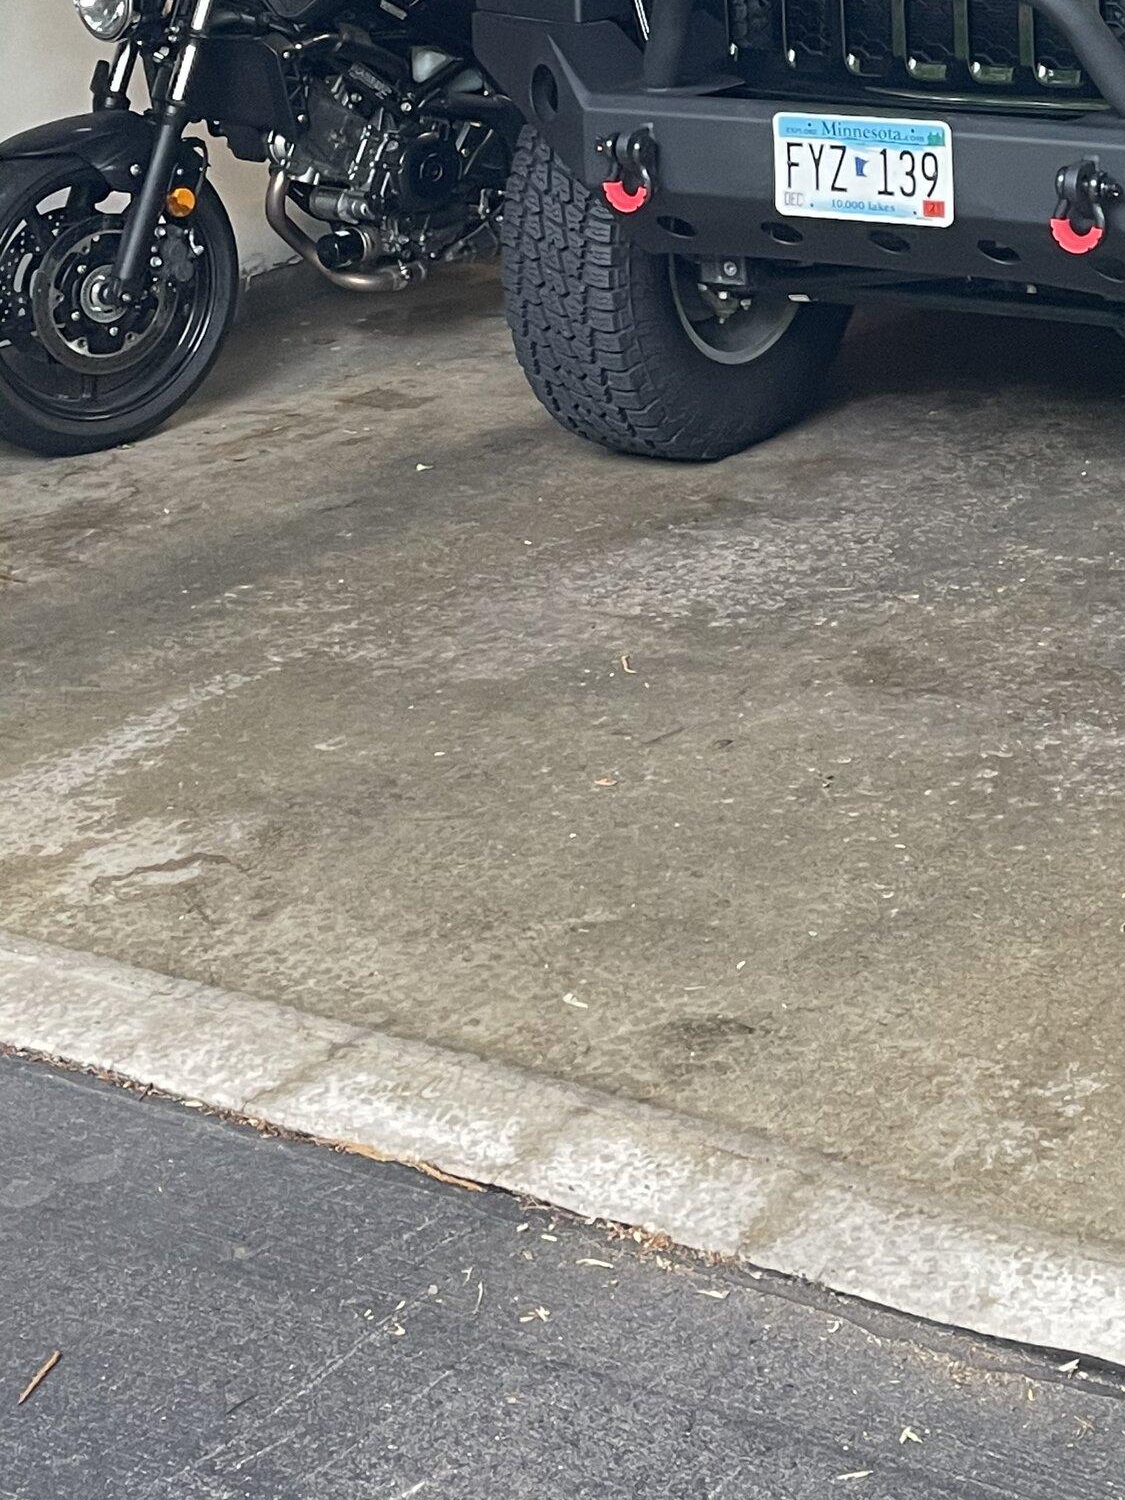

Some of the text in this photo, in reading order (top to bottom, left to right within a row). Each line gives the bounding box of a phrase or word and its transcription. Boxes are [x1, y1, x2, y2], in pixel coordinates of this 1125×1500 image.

[786, 142, 939, 198] FYZ 139
[784, 191, 804, 207] DEC
[868, 200, 895, 212] lakes
